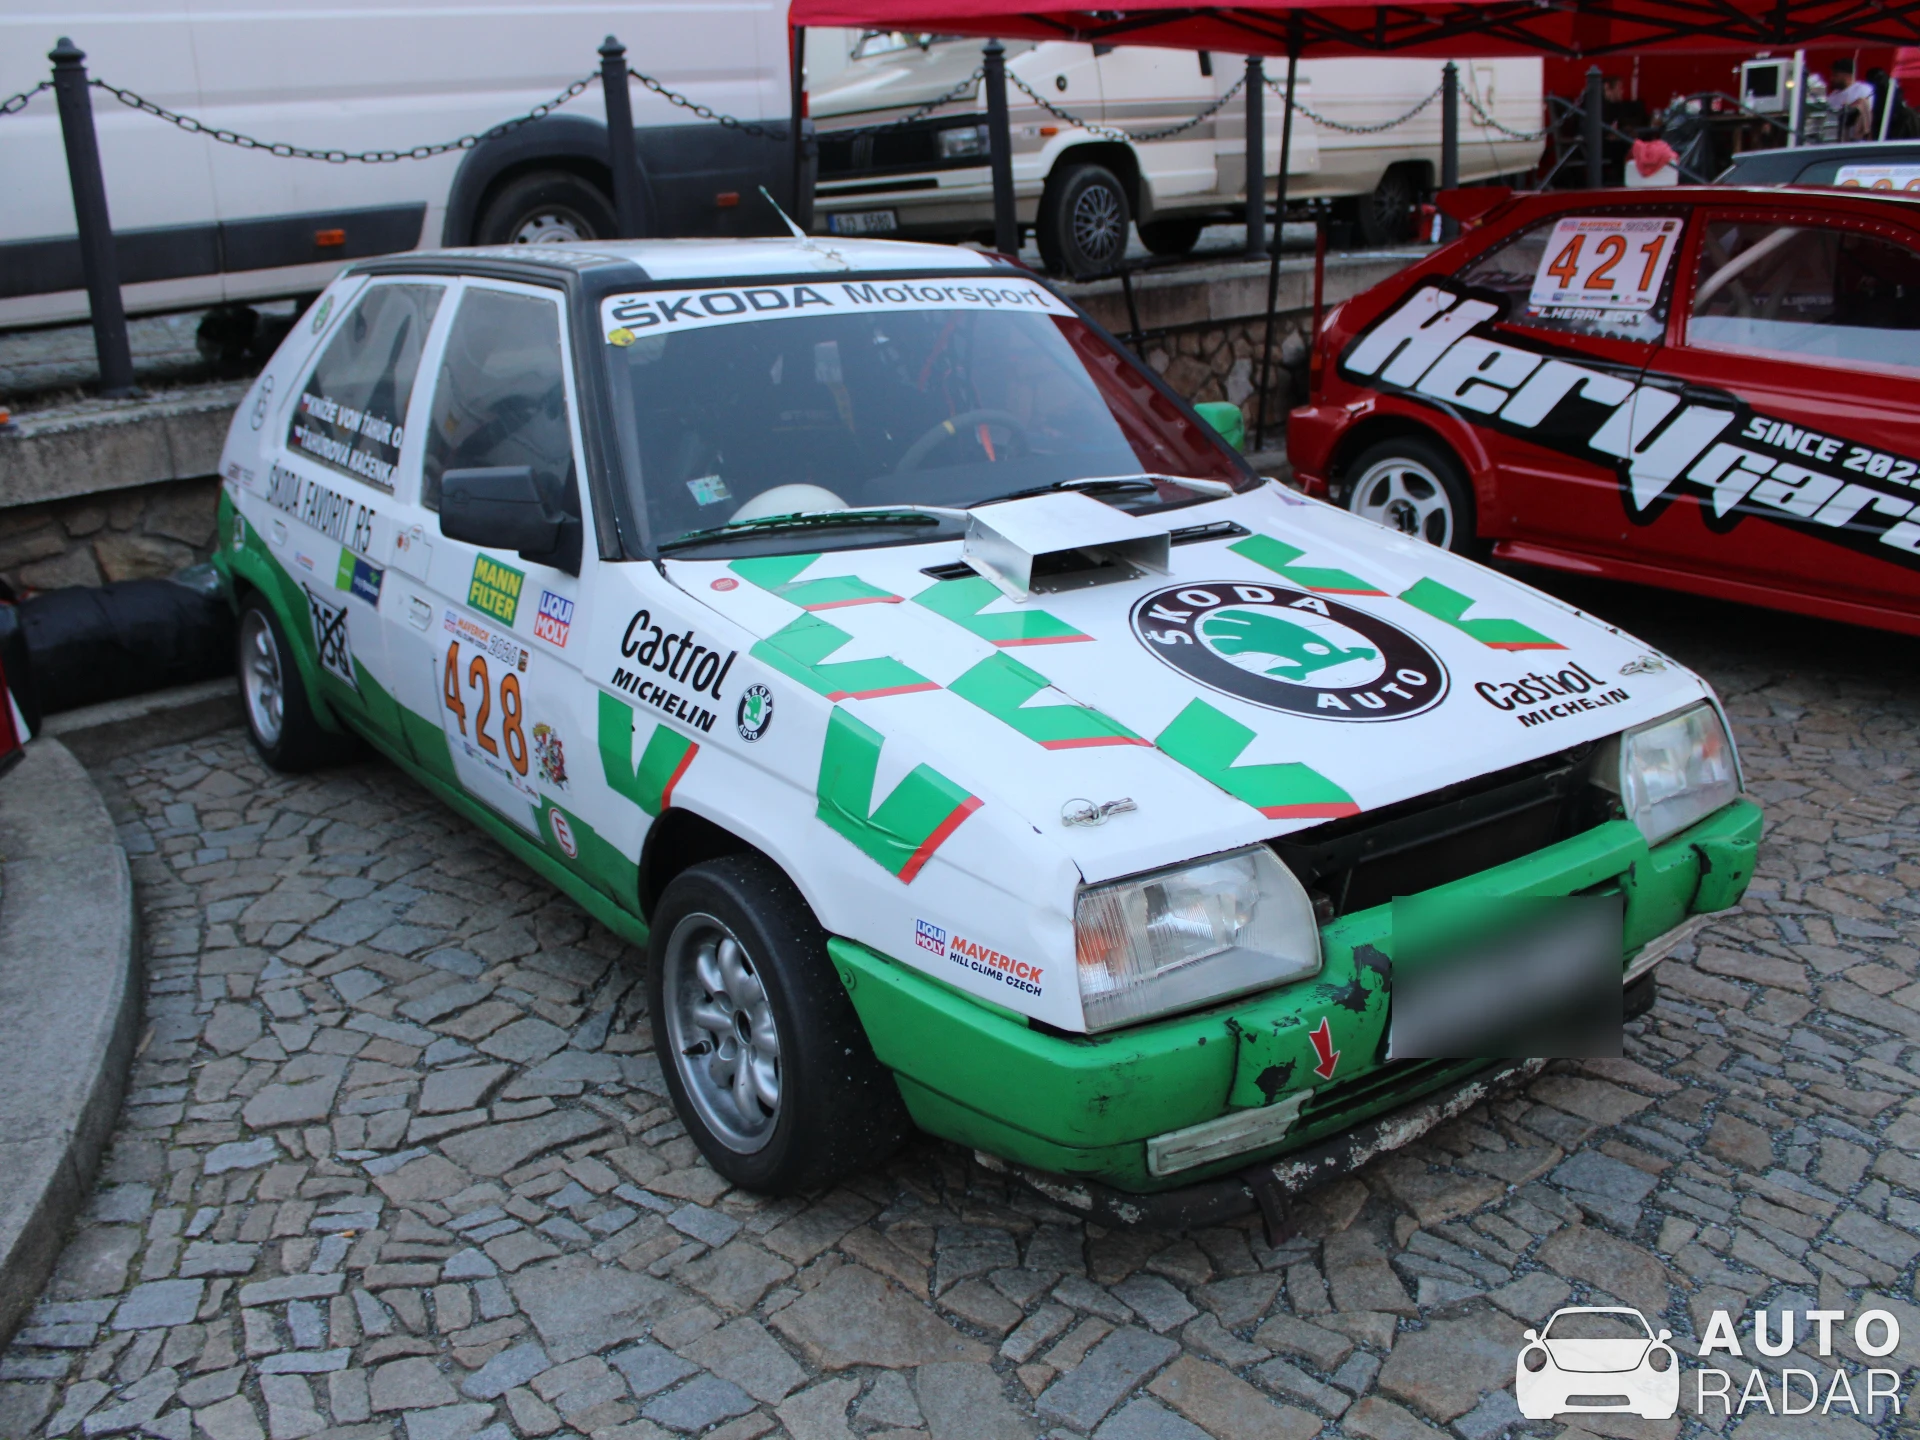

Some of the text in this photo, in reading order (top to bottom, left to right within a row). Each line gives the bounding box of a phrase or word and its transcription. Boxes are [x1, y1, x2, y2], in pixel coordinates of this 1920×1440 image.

[1547, 234, 1668, 291] 421
[612, 283, 1051, 330] ŠKODA Motorsport
[337, 405, 364, 433] VON
[1344, 286, 1736, 512] Hery
[1741, 416, 1844, 463] SINCE
[301, 480, 354, 544] FAVORIT
[353, 504, 376, 553] R5
[474, 558, 521, 597] MANN
[469, 581, 515, 621] FILTER
[540, 592, 574, 624] LIQUI
[1144, 585, 1330, 645] ŠKODA
[535, 614, 570, 647] MOLY
[621, 609, 739, 701] Castrol
[443, 640, 529, 777] 428
[611, 667, 717, 733] MICHELIN
[1316, 668, 1427, 711] AUTO
[1474, 661, 1608, 711] Castrol
[1516, 687, 1632, 728] MICHELIN
[739, 724, 758, 740] AUTO
[916, 920, 946, 943] LIQUI
[916, 933, 945, 956] MOLY
[949, 951, 1043, 997] HILL CLIMB CZECH
[950, 935, 1044, 984] MAVERICK
